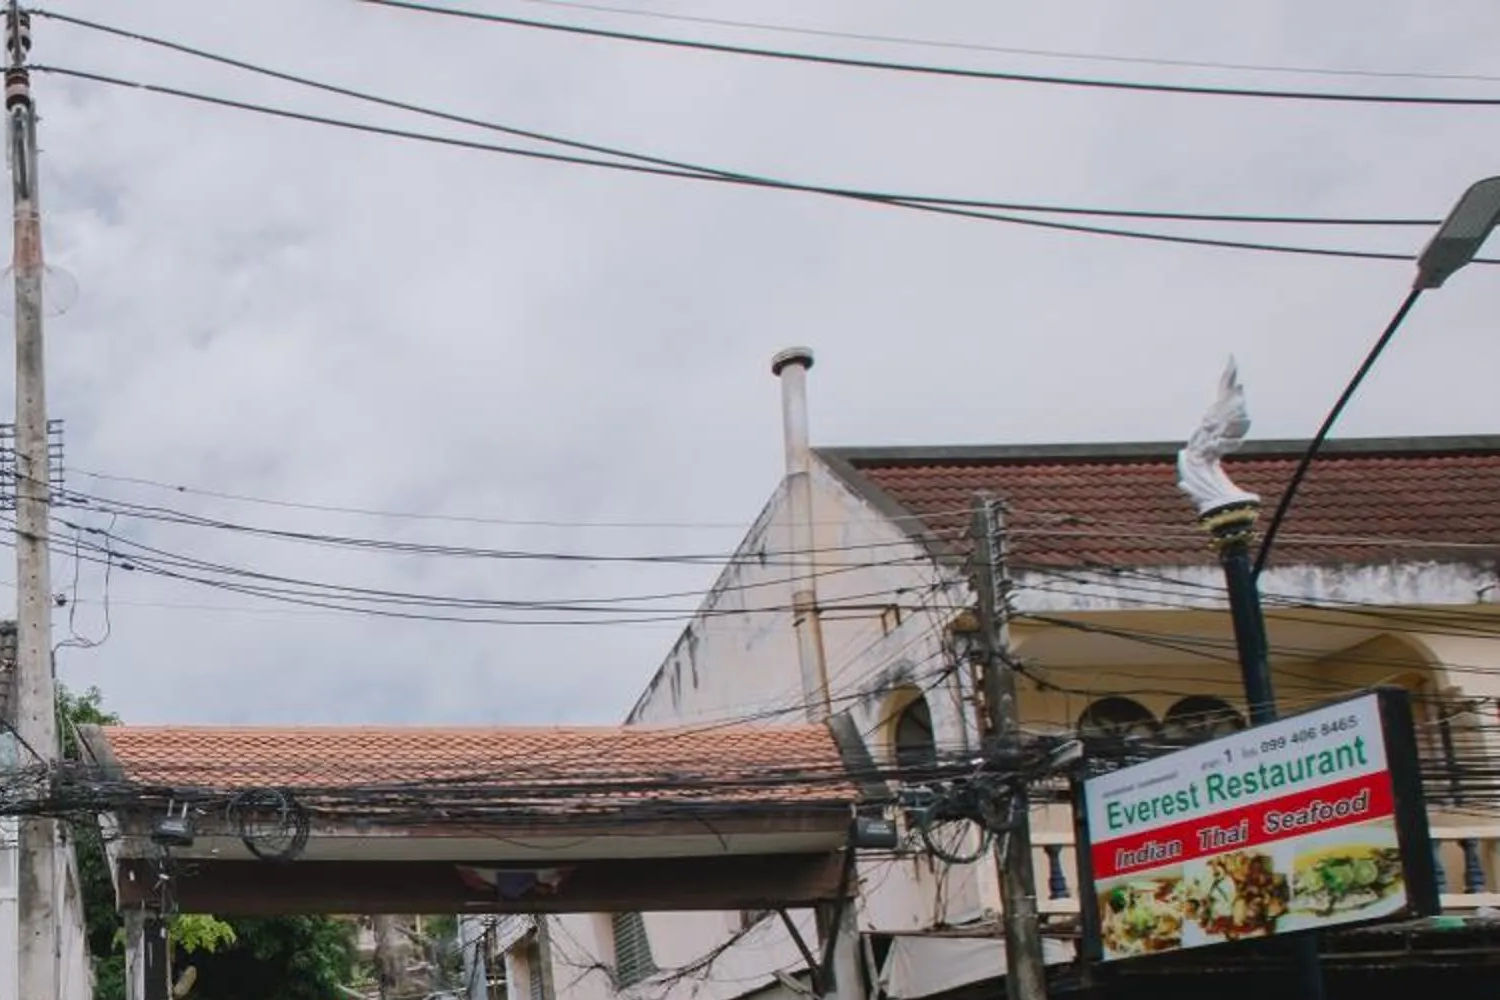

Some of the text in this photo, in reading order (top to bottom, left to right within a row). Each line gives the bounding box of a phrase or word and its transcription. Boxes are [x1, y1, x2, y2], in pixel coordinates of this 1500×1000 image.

[1107, 782, 1200, 830] Everest
[1206, 734, 1368, 804] Restaurant
[1114, 788, 1370, 870] Indian Thai Seafood
